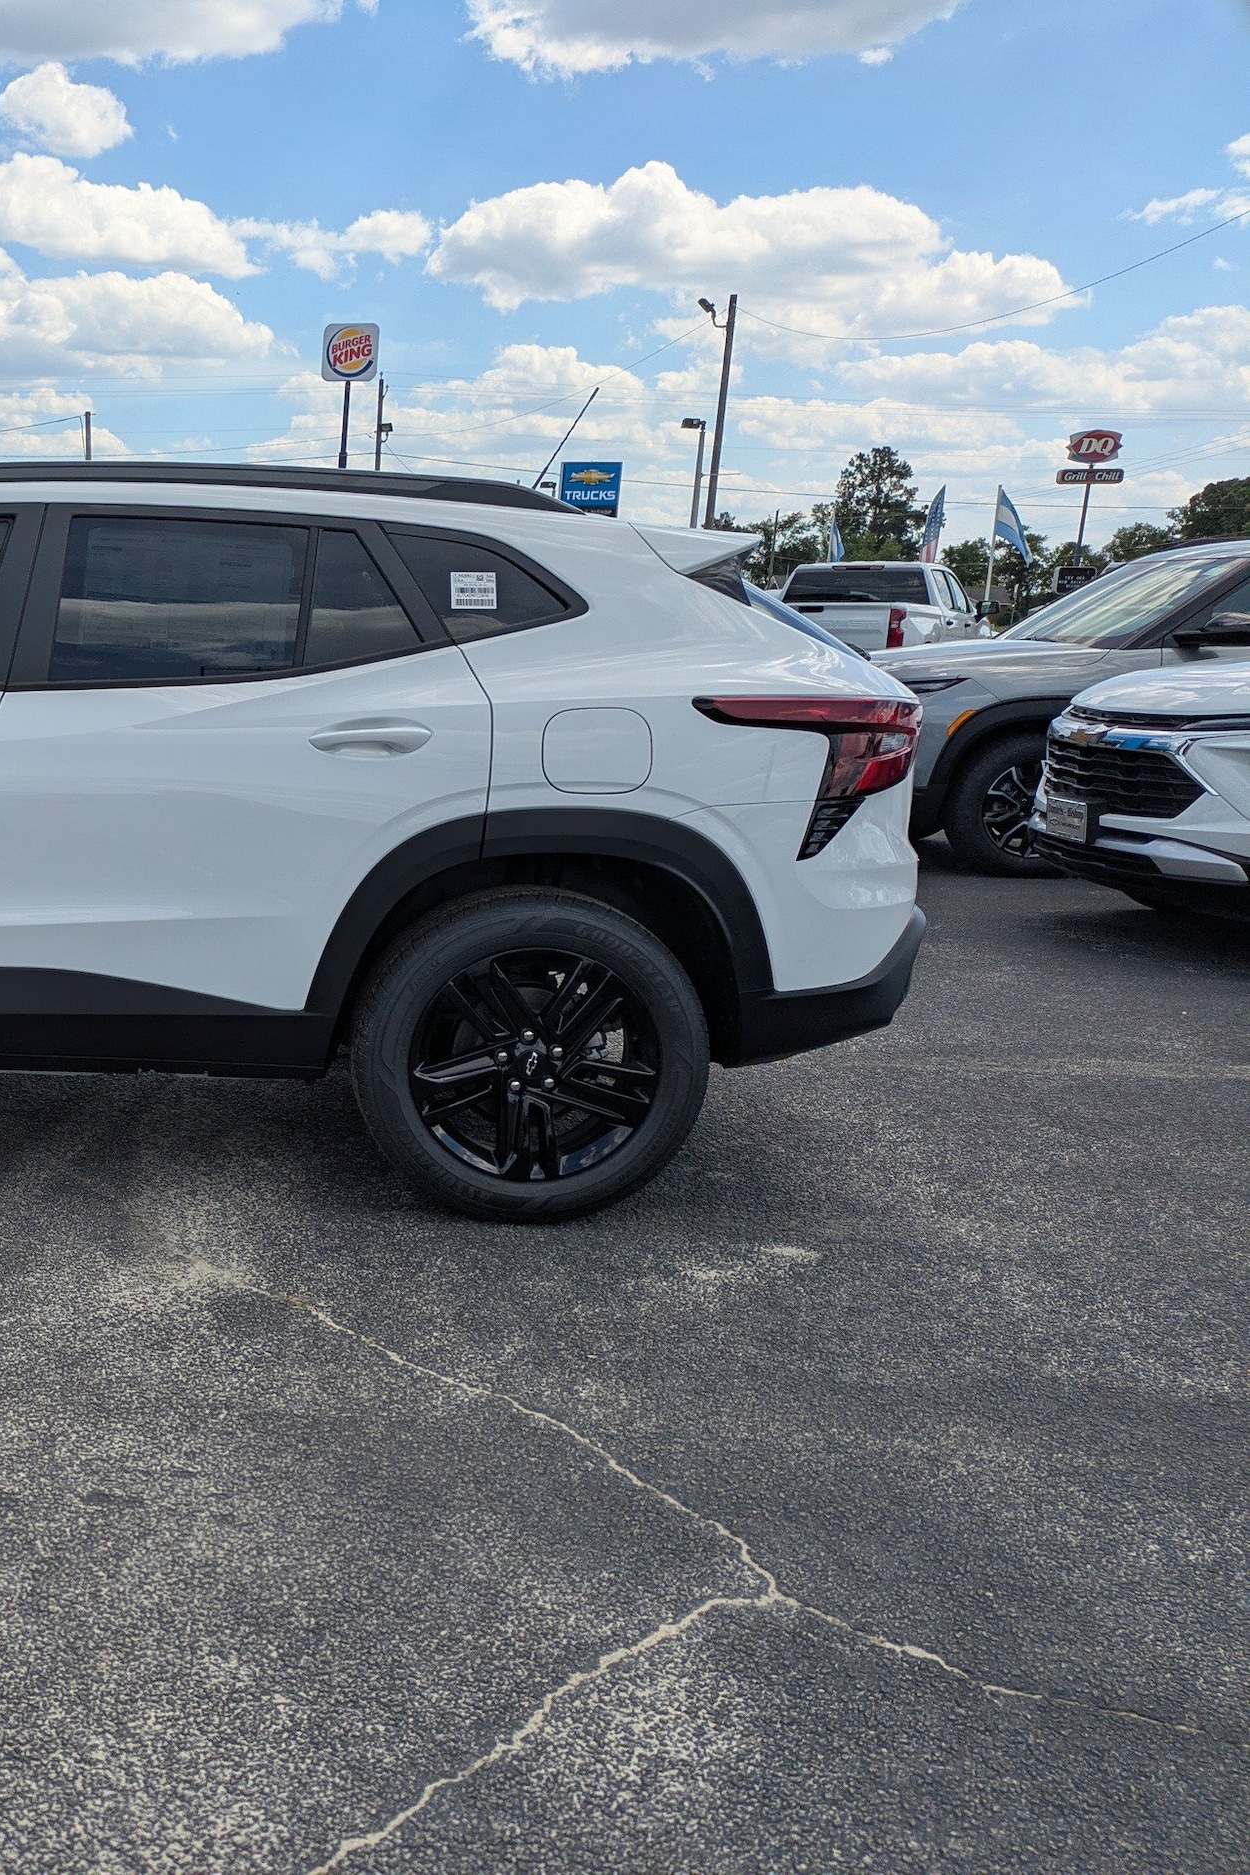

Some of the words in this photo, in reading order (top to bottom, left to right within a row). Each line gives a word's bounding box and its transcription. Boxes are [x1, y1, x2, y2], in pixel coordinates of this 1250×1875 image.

[331, 335, 371, 355] BURGER
[332, 344, 373, 368] KING
[1078, 437, 1115, 456] DQ
[1064, 472, 1088, 481] Grill
[1094, 472, 1120, 481] Chill
[564, 490, 617, 501] TRUCKS
